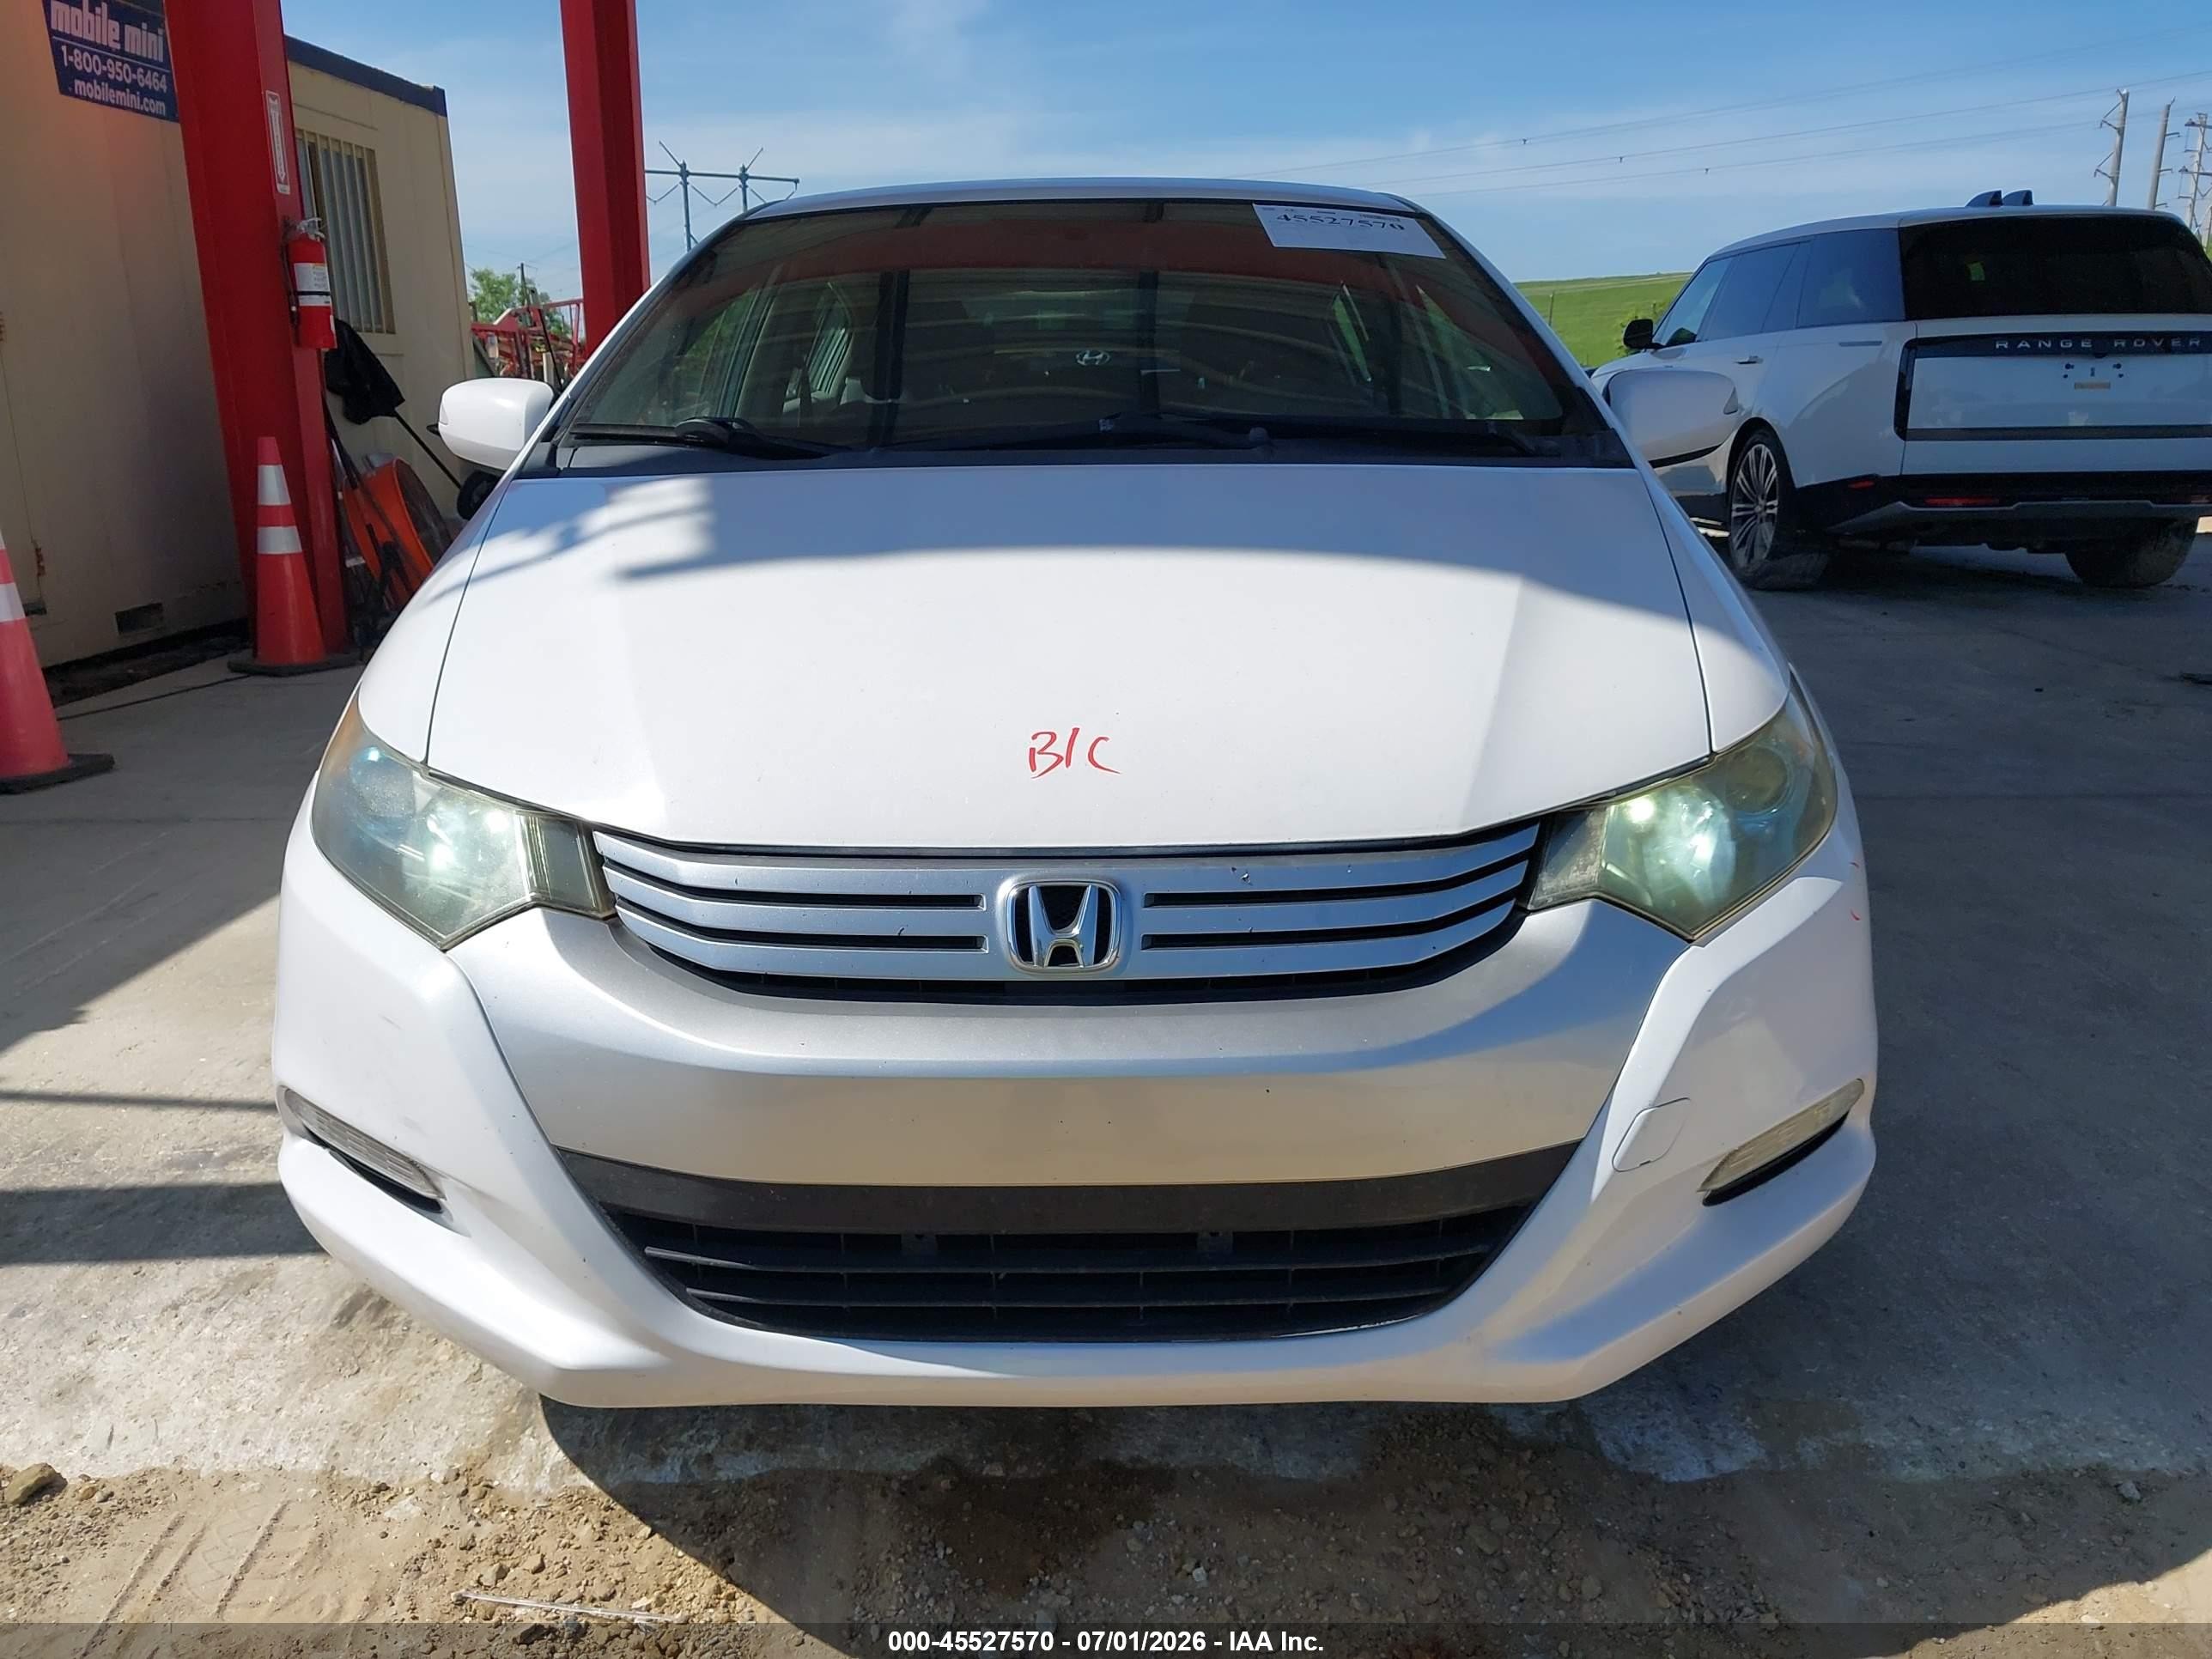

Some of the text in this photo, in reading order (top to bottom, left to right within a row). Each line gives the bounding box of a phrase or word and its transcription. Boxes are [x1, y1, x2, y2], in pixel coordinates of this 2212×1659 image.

[51, 0, 165, 63] mobile mini
[61, 45, 167, 94] 1-800-950-6464
[74, 78, 166, 116] mobilemini.com
[1277, 214, 1405, 230] 45527570
[1995, 337, 2202, 349] RANGE ROVER
